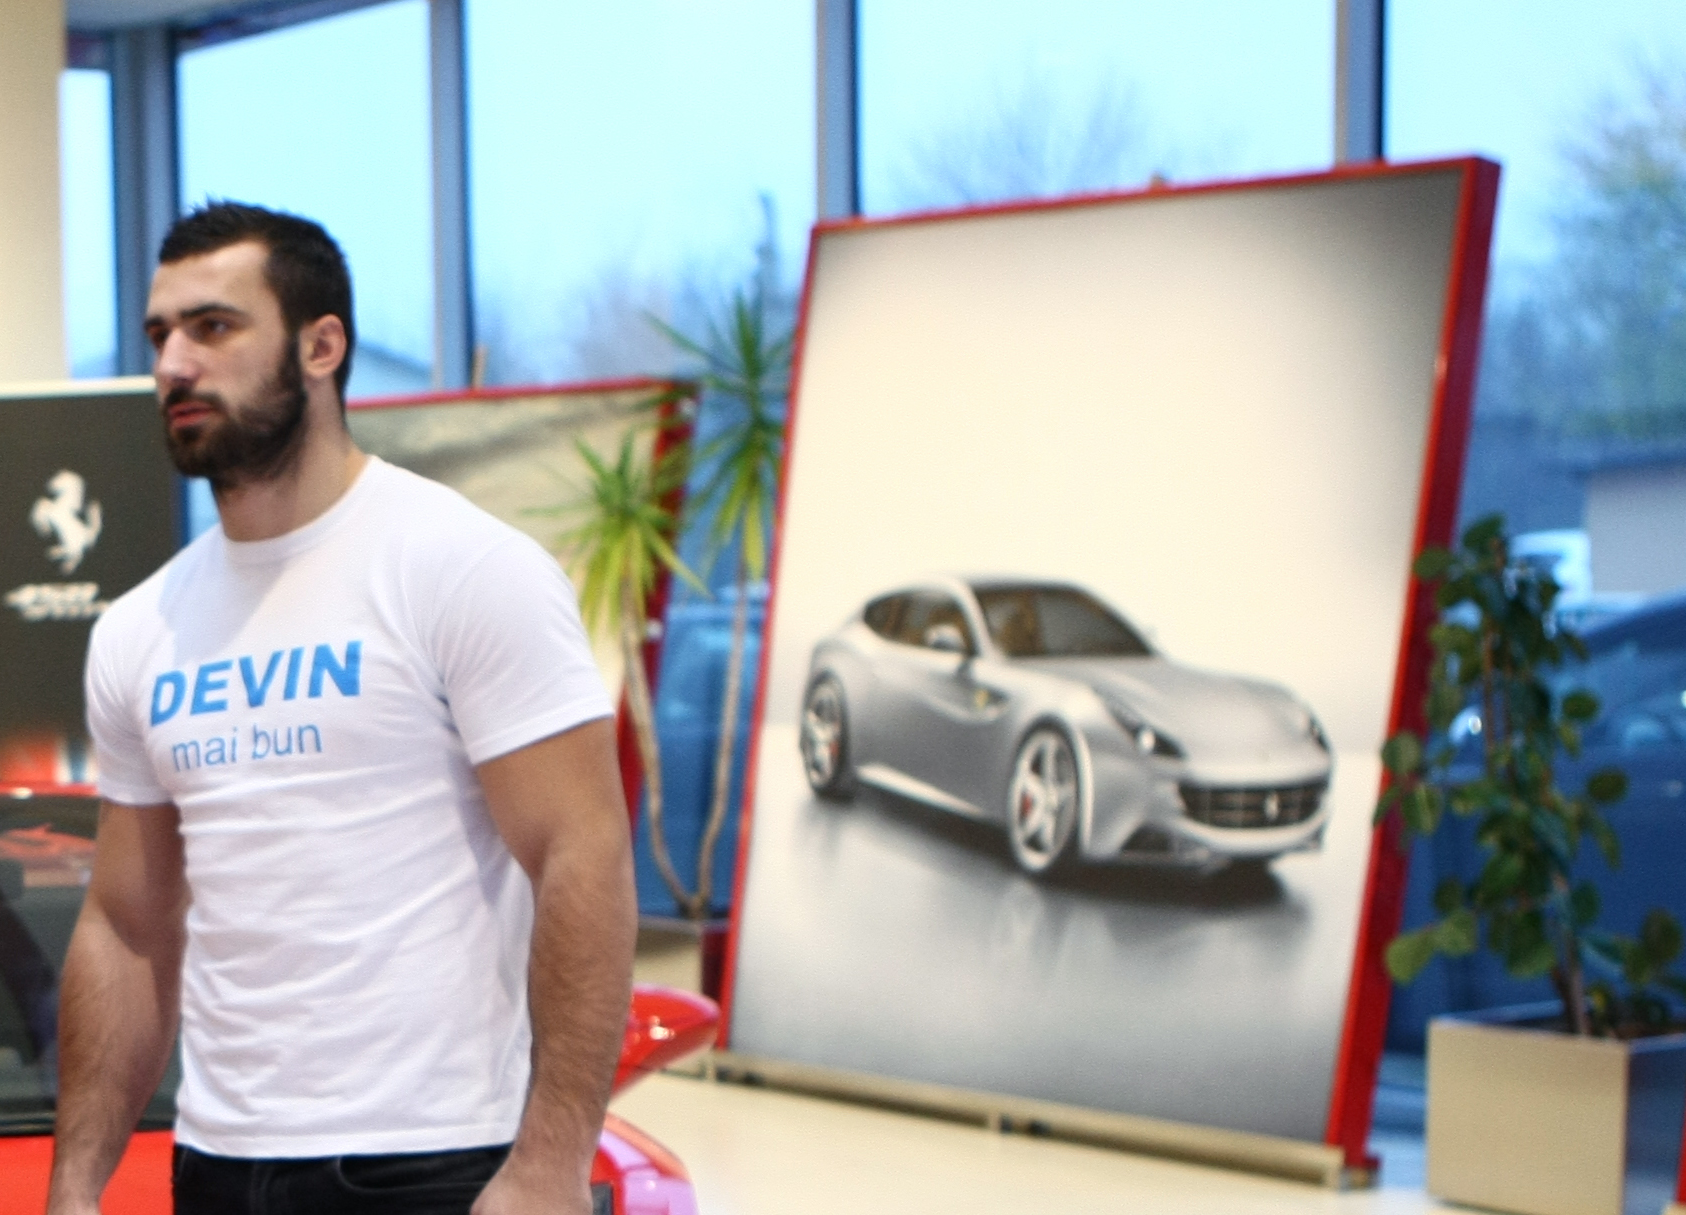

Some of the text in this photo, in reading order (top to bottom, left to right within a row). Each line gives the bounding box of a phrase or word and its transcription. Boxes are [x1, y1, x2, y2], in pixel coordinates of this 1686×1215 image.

[150, 640, 363, 727] DEVIN
[171, 721, 323, 773] mai bun
